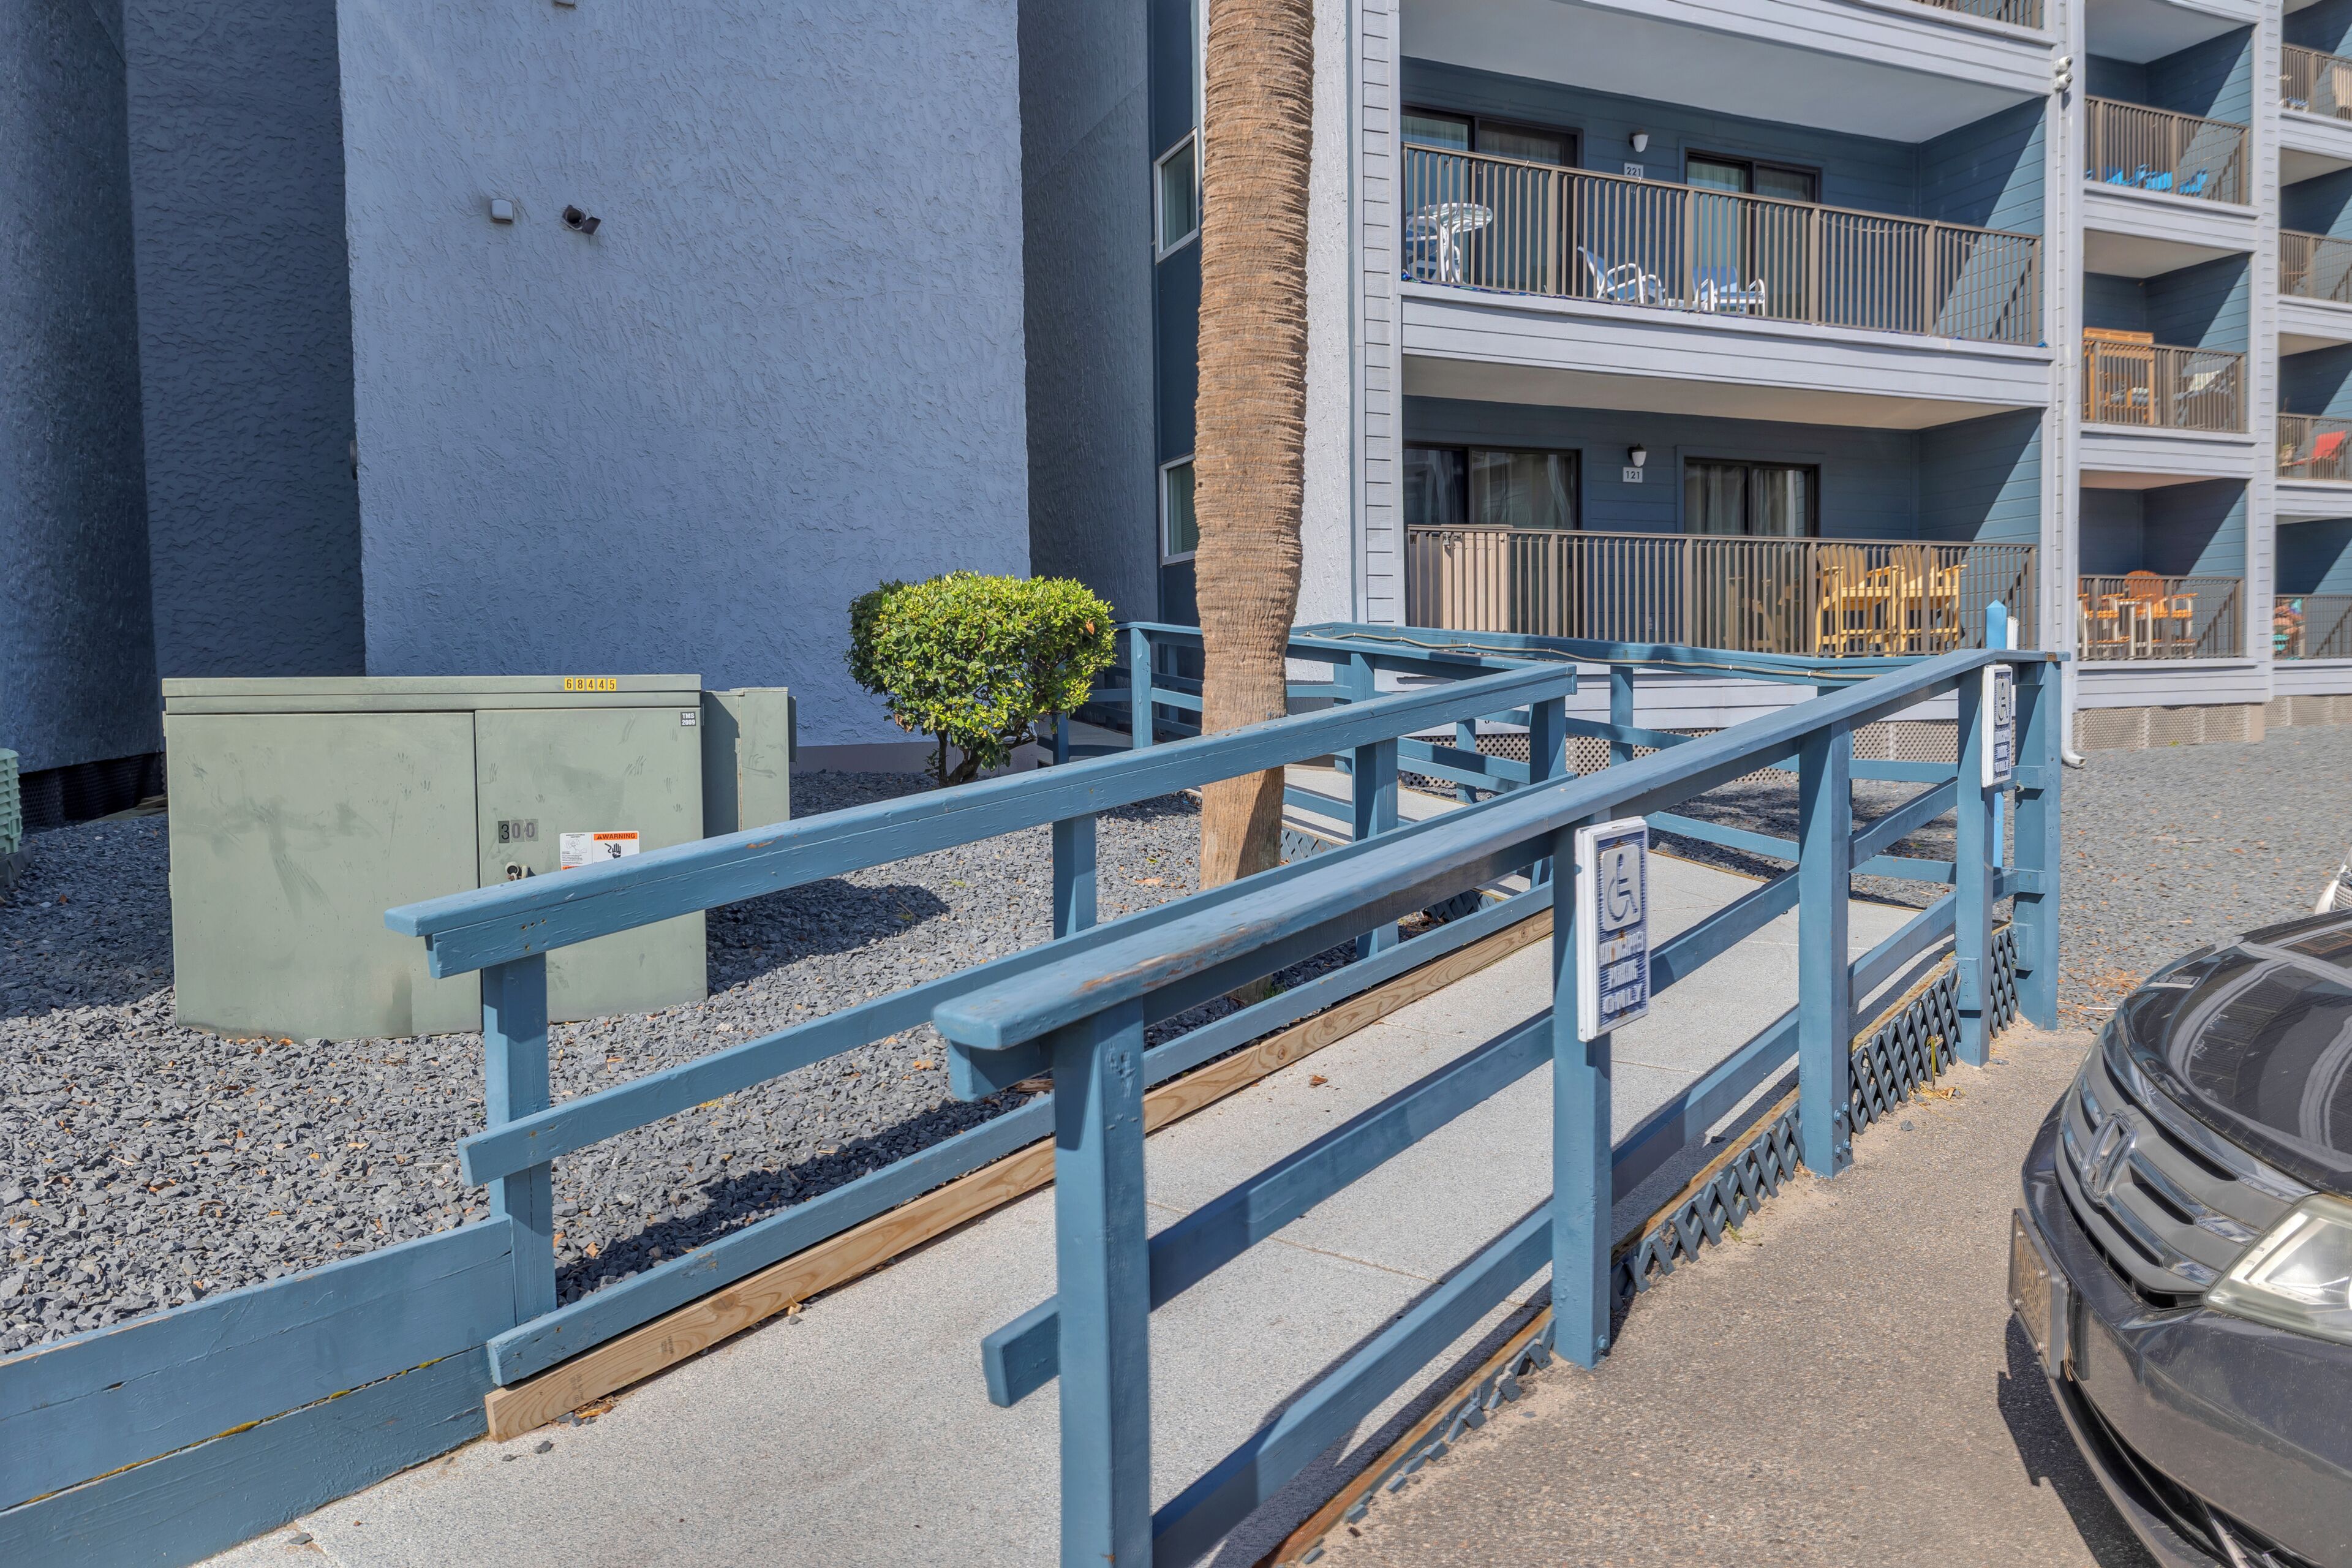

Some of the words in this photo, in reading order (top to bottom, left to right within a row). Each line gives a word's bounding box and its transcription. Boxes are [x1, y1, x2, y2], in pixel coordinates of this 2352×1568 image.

[1627, 167, 1641, 176] 221
[1626, 470, 1640, 480] 121
[566, 679, 615, 690] 68445
[501, 822, 535, 840] 300
[1604, 982, 1643, 1014] ONLY
